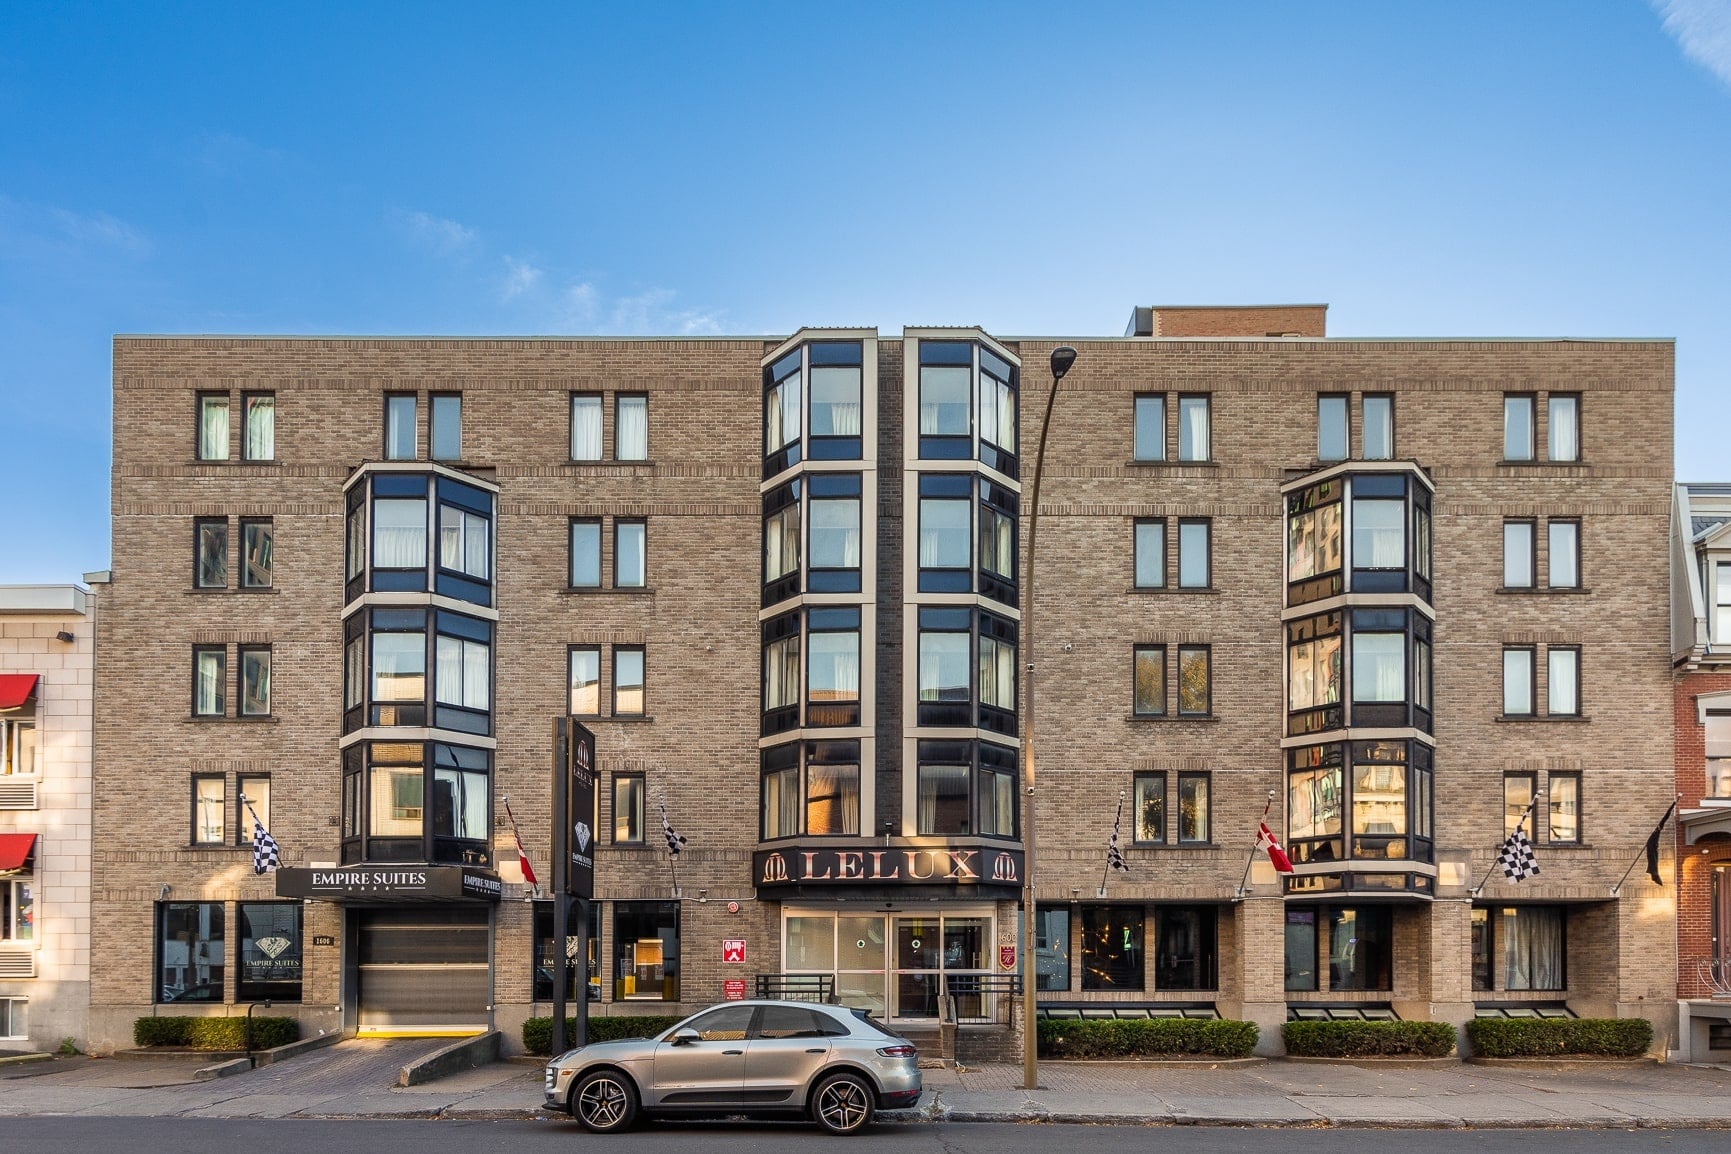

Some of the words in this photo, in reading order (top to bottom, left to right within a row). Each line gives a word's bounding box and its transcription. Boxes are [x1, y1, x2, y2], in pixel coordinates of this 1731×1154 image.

[800, 850, 980, 880] LELUX
[312, 872, 370, 885] EMPIRE
[373, 872, 426, 885] SUITES
[464, 874, 484, 888] EMPIRE
